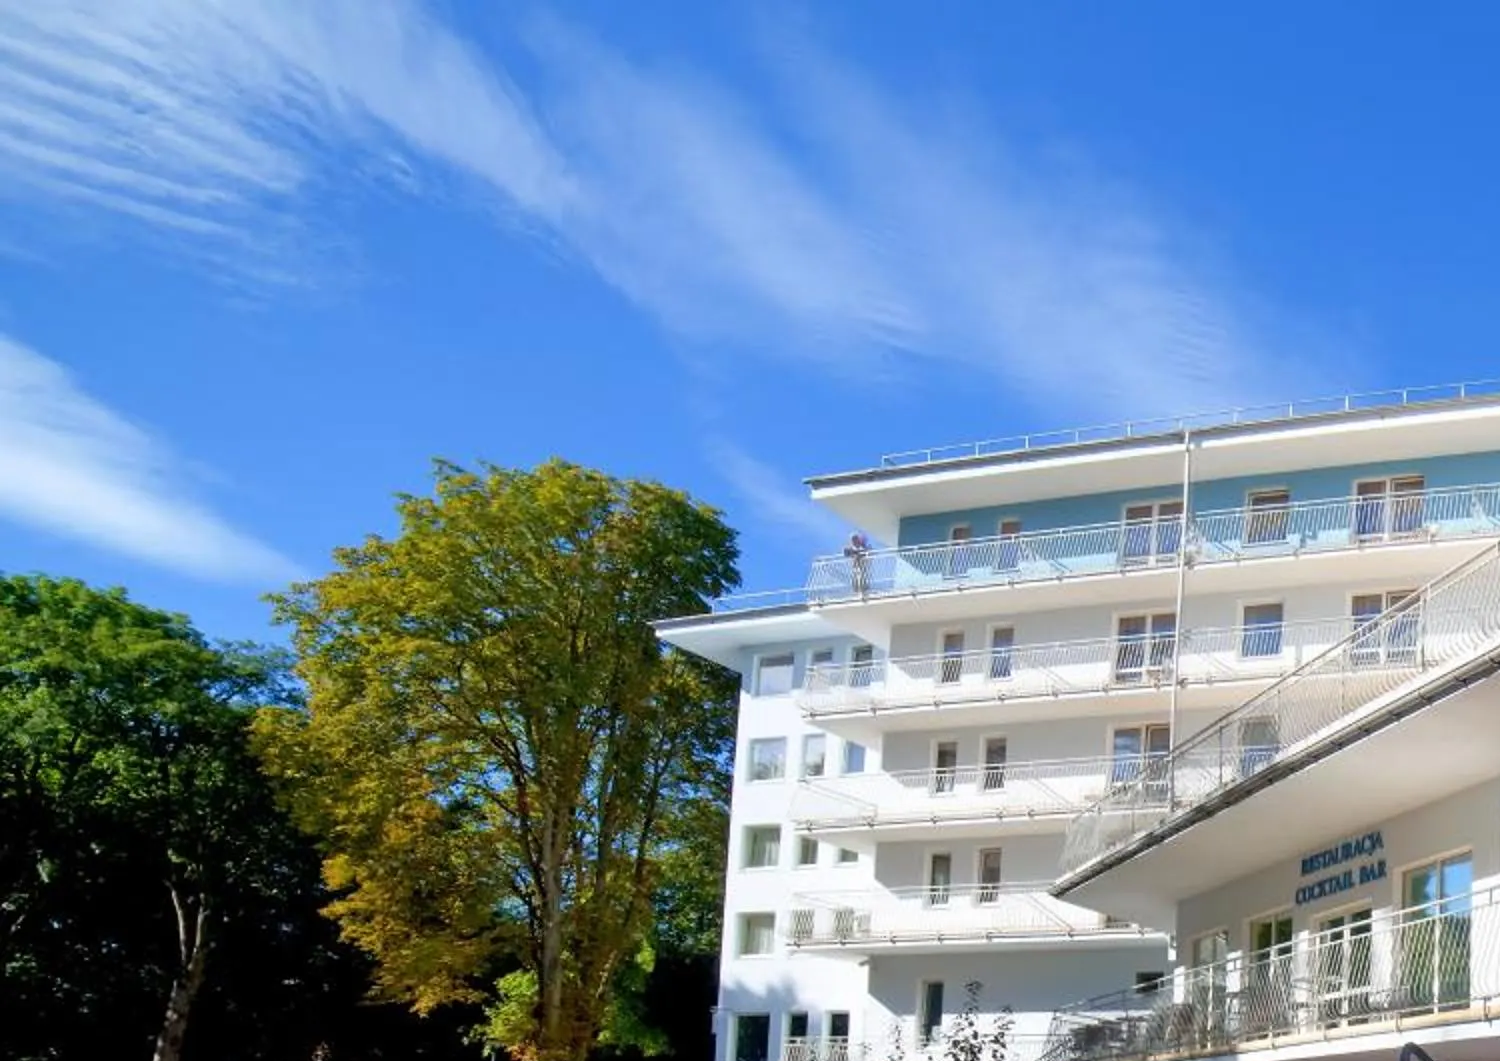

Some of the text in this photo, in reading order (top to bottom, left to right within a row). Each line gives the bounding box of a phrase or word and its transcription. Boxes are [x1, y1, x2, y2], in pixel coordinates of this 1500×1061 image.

[1301, 831, 1384, 877] RESTAURACJA
[1295, 858, 1387, 905] COCKTAIL BAR
